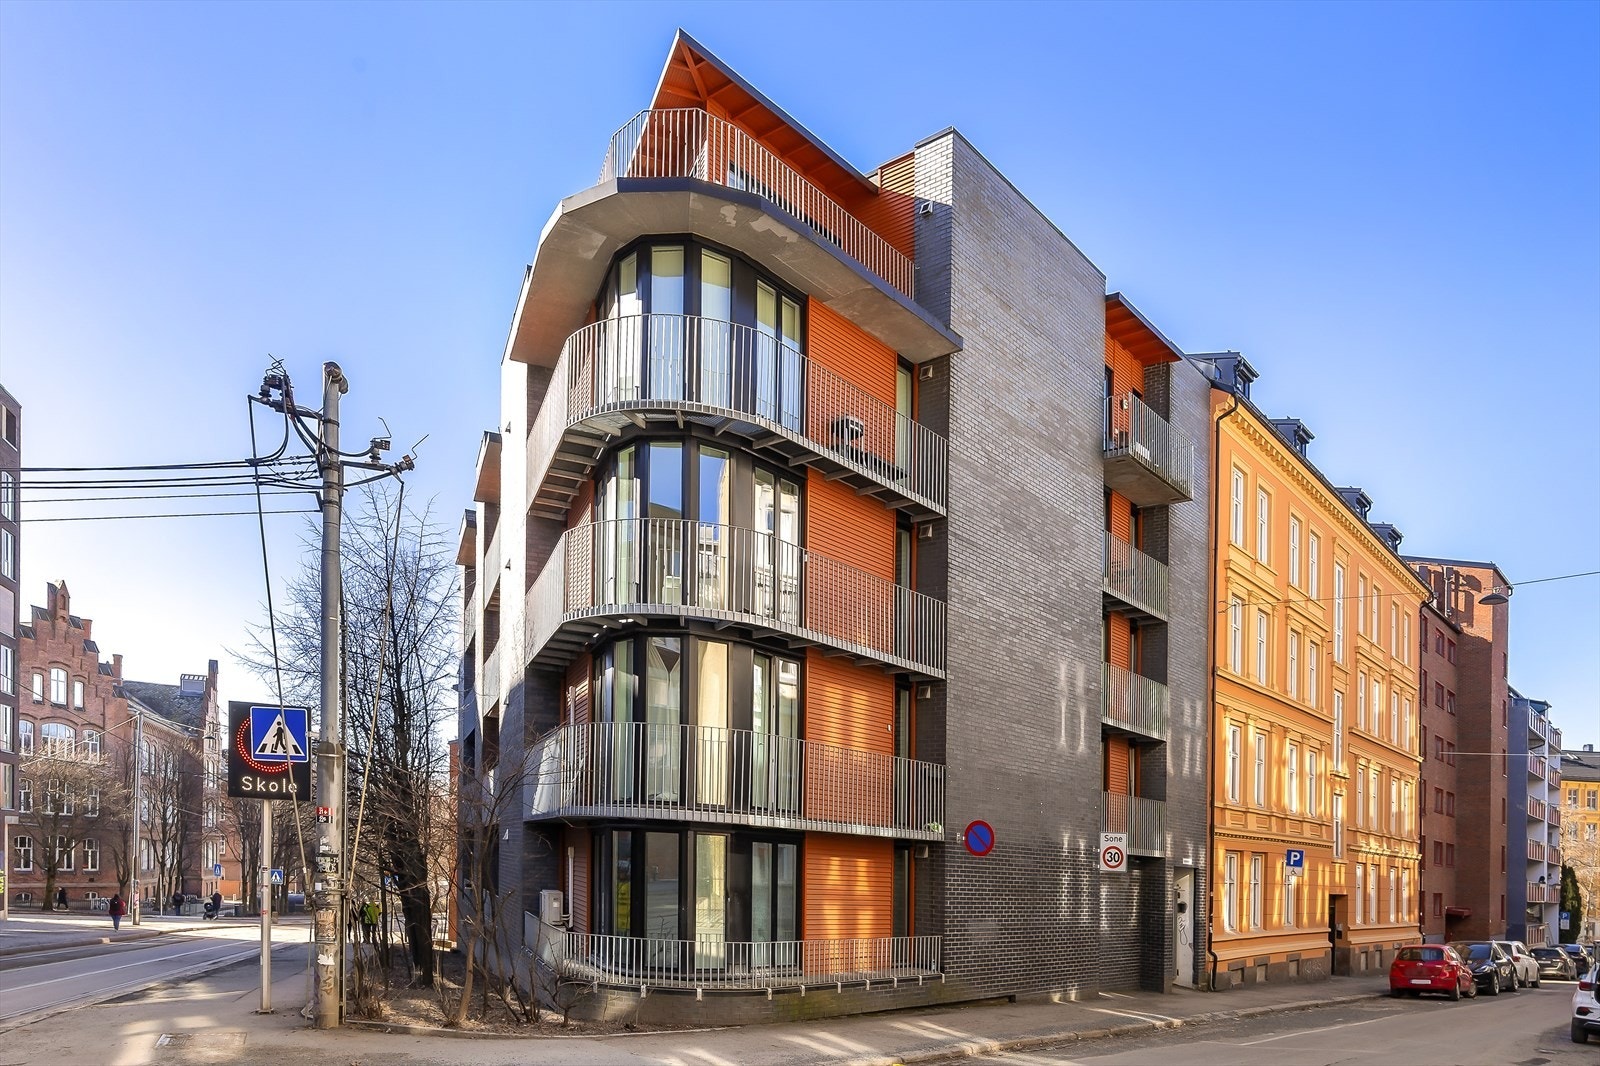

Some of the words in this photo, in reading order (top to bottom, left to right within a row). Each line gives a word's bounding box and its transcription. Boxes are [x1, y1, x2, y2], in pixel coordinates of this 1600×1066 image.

[241, 776, 297, 793] Skole
[1104, 834, 1123, 843] Sone
[1106, 851, 1120, 863] 30
[1290, 851, 1300, 865] P
